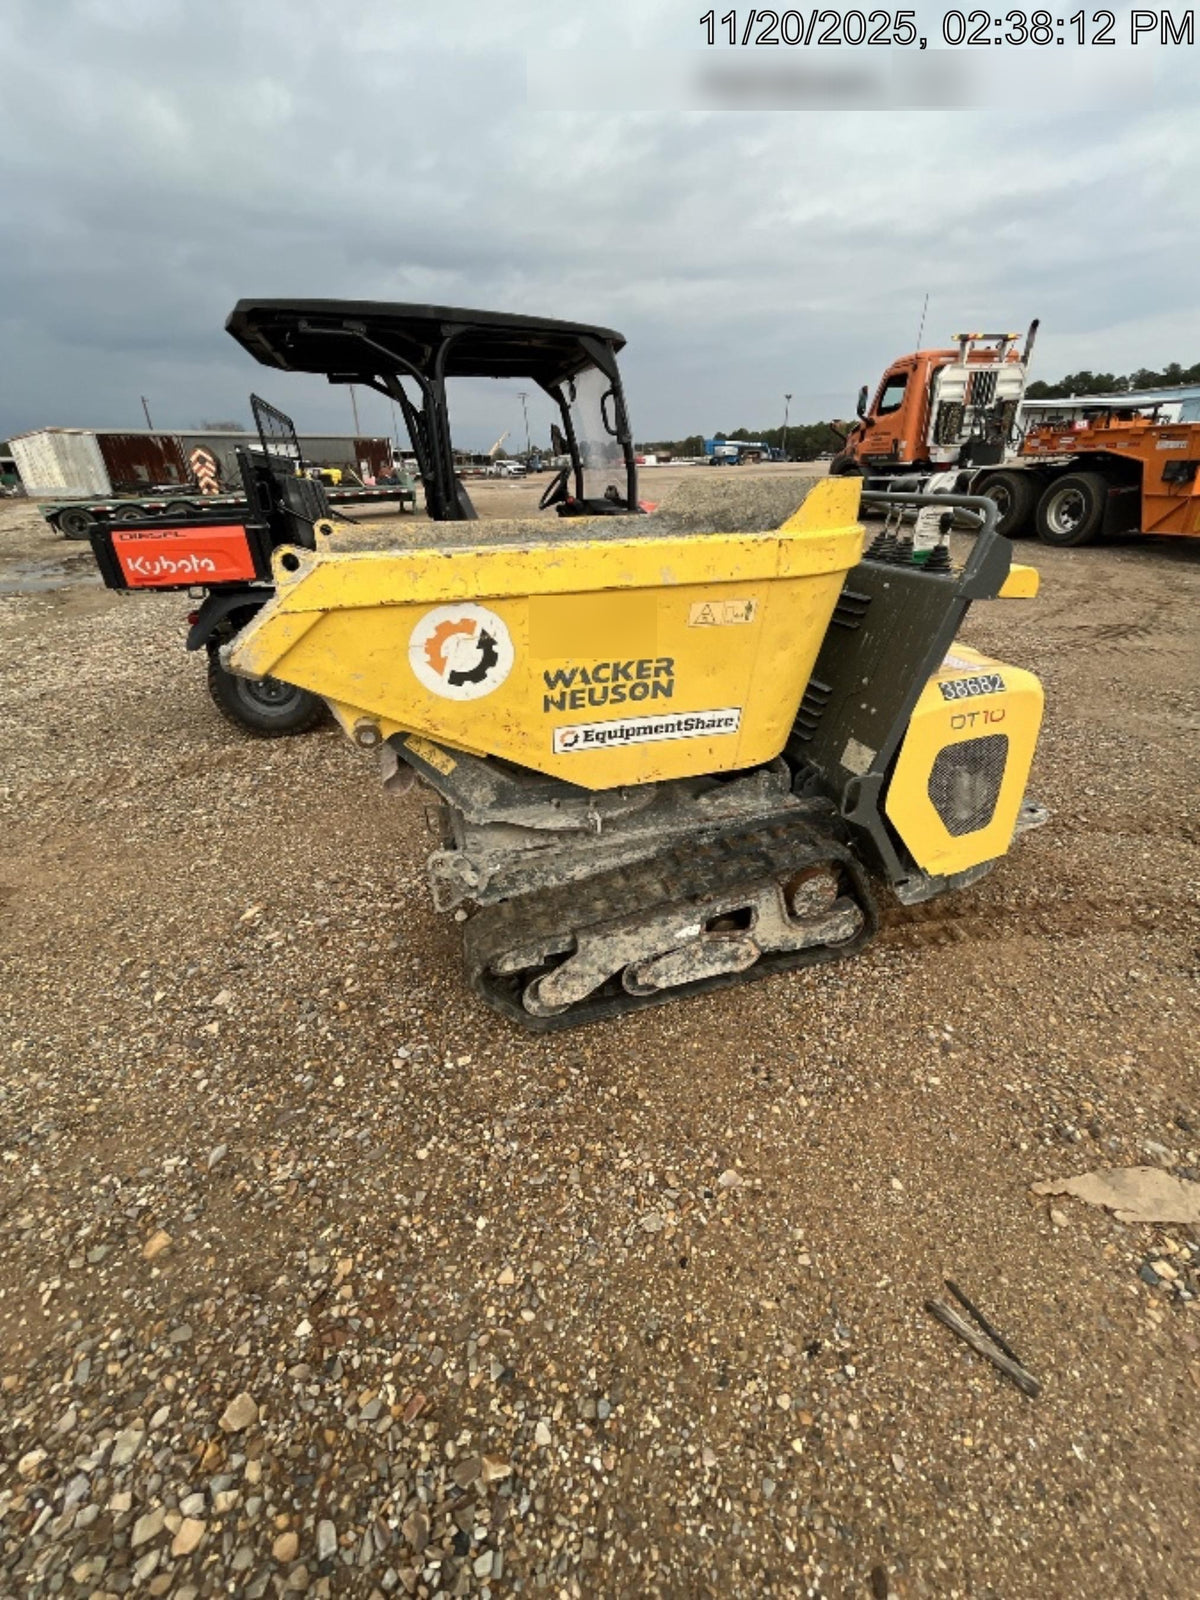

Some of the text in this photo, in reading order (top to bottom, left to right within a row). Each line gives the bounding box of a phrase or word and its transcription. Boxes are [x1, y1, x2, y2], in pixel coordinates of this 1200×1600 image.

[126, 553, 216, 576] Kubota
[543, 657, 675, 691] WACKER
[940, 674, 1006, 700] 38682
[543, 679, 675, 713] NEUSON
[582, 714, 735, 745] EquipmentShare
